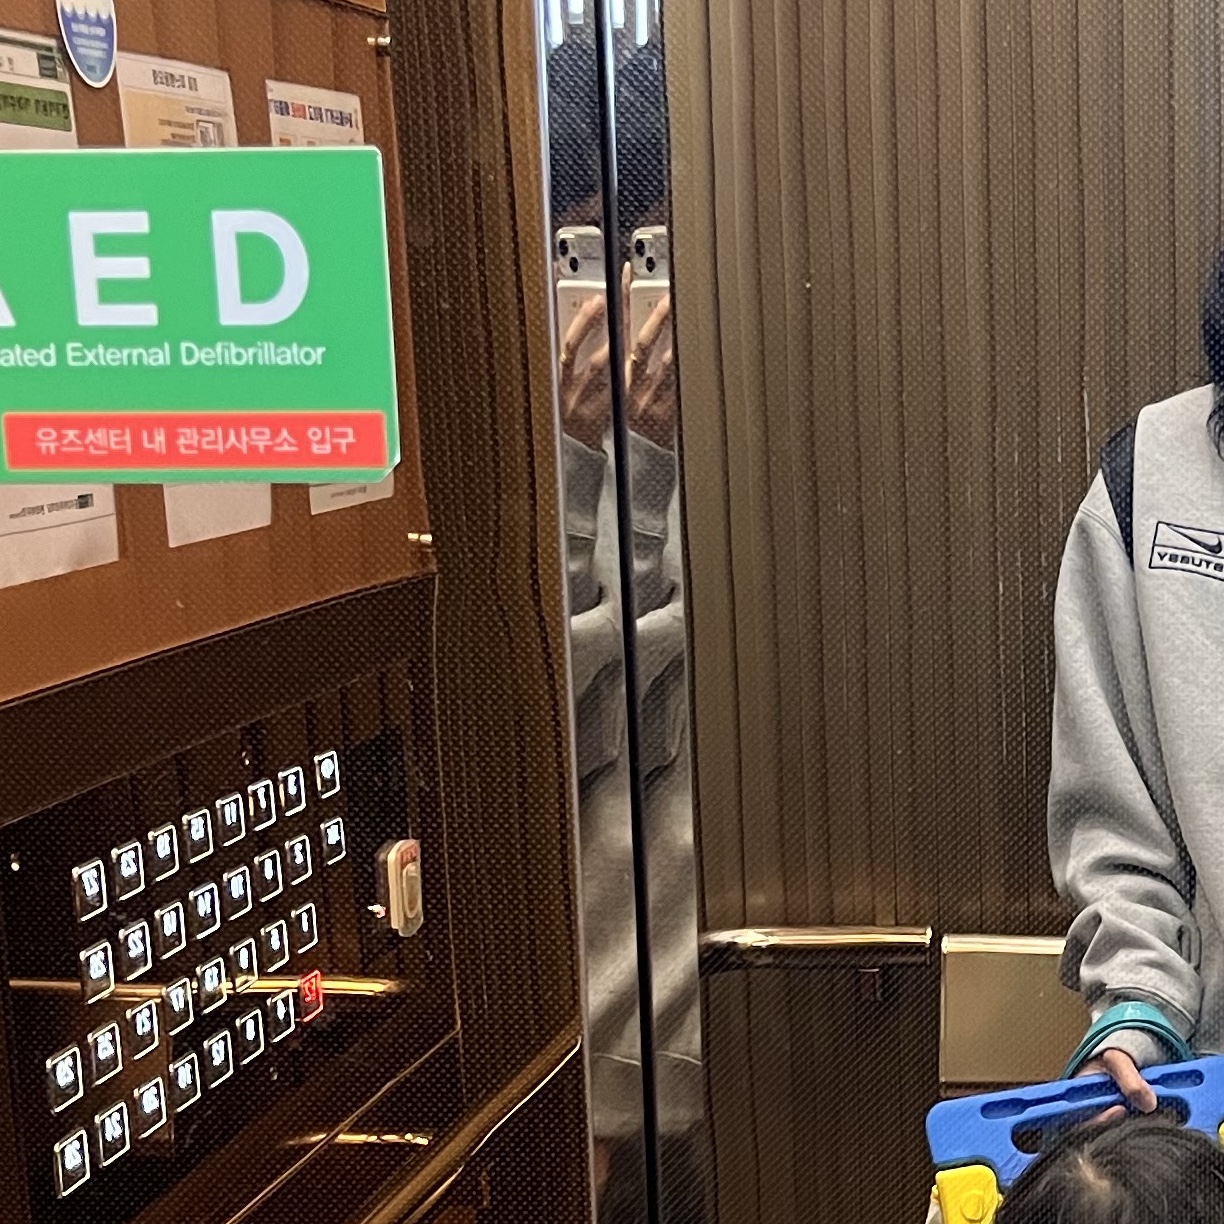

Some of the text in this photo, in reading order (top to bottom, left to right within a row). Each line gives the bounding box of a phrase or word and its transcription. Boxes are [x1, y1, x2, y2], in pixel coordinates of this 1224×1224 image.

[0, 209, 310, 326] ED
[66, 342, 171, 367] External
[180, 342, 327, 366] Defibrillator
[35, 427, 357, 455] 유즈센터 내 관리사무소 입구
